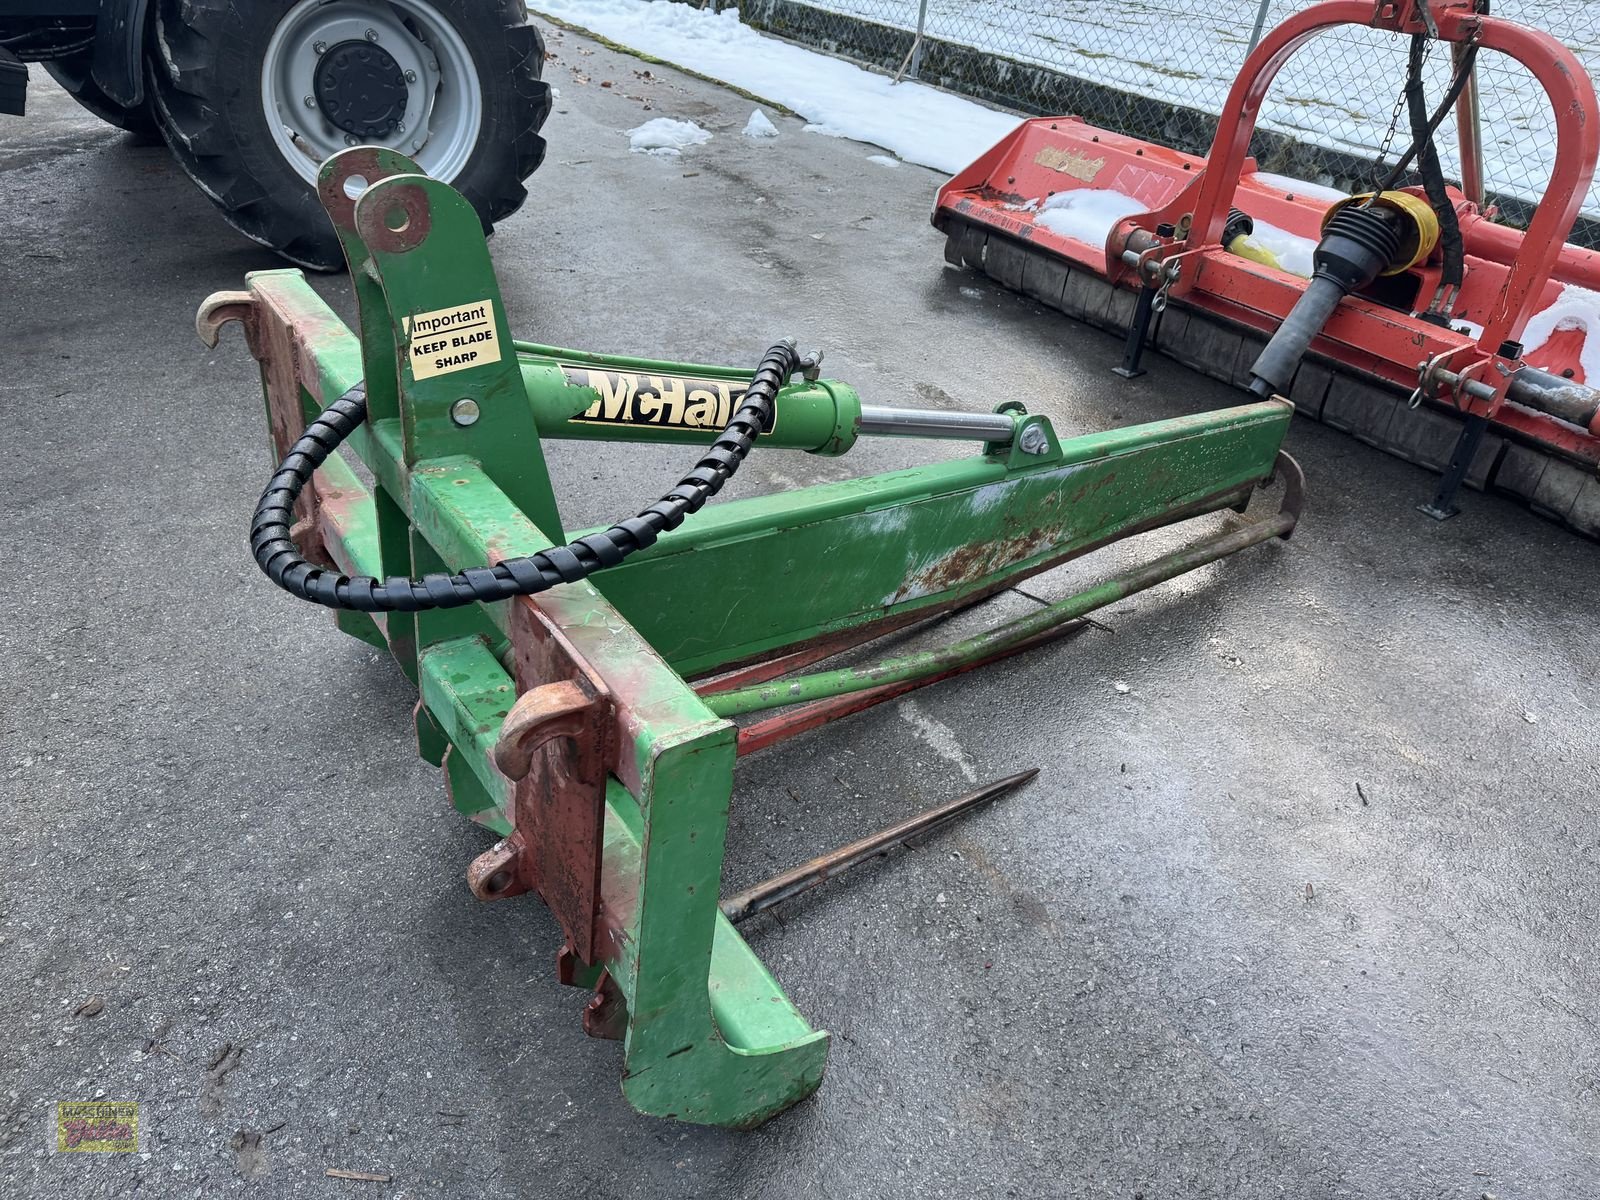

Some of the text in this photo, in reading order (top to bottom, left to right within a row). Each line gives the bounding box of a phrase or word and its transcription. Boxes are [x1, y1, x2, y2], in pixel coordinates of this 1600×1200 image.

[414, 306, 486, 332] Important
[413, 330, 493, 357] KEEP BLADE
[435, 351, 478, 369] SHARP
